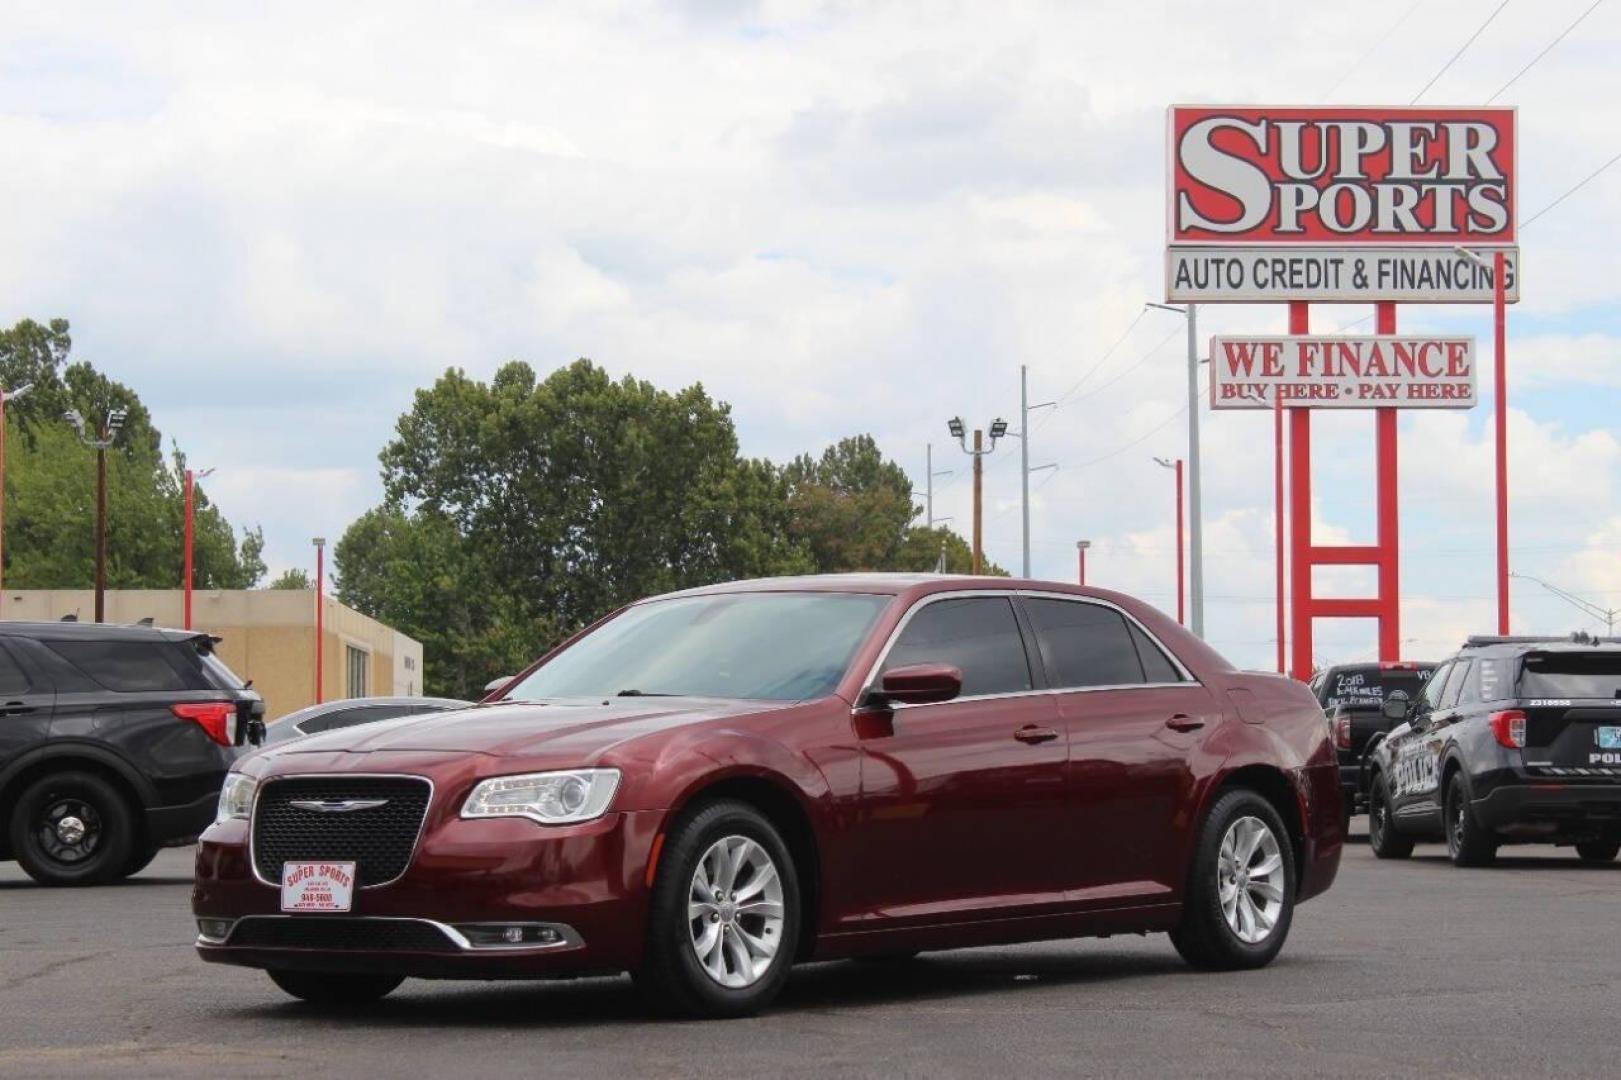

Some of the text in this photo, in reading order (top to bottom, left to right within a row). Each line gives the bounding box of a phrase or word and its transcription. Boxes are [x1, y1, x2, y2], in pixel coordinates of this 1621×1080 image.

[1179, 117, 1504, 233] SUPER
[1175, 258, 1514, 290] AUTO CREDIT & FINANCING
[1222, 341, 1470, 378] WE FINANCE
[1220, 383, 1472, 400] BUY HERE PAY HERE
[1337, 674, 1365, 687] 2018
[1589, 753, 1621, 763] POL
[287, 864, 350, 887] SUPER SPORTS
